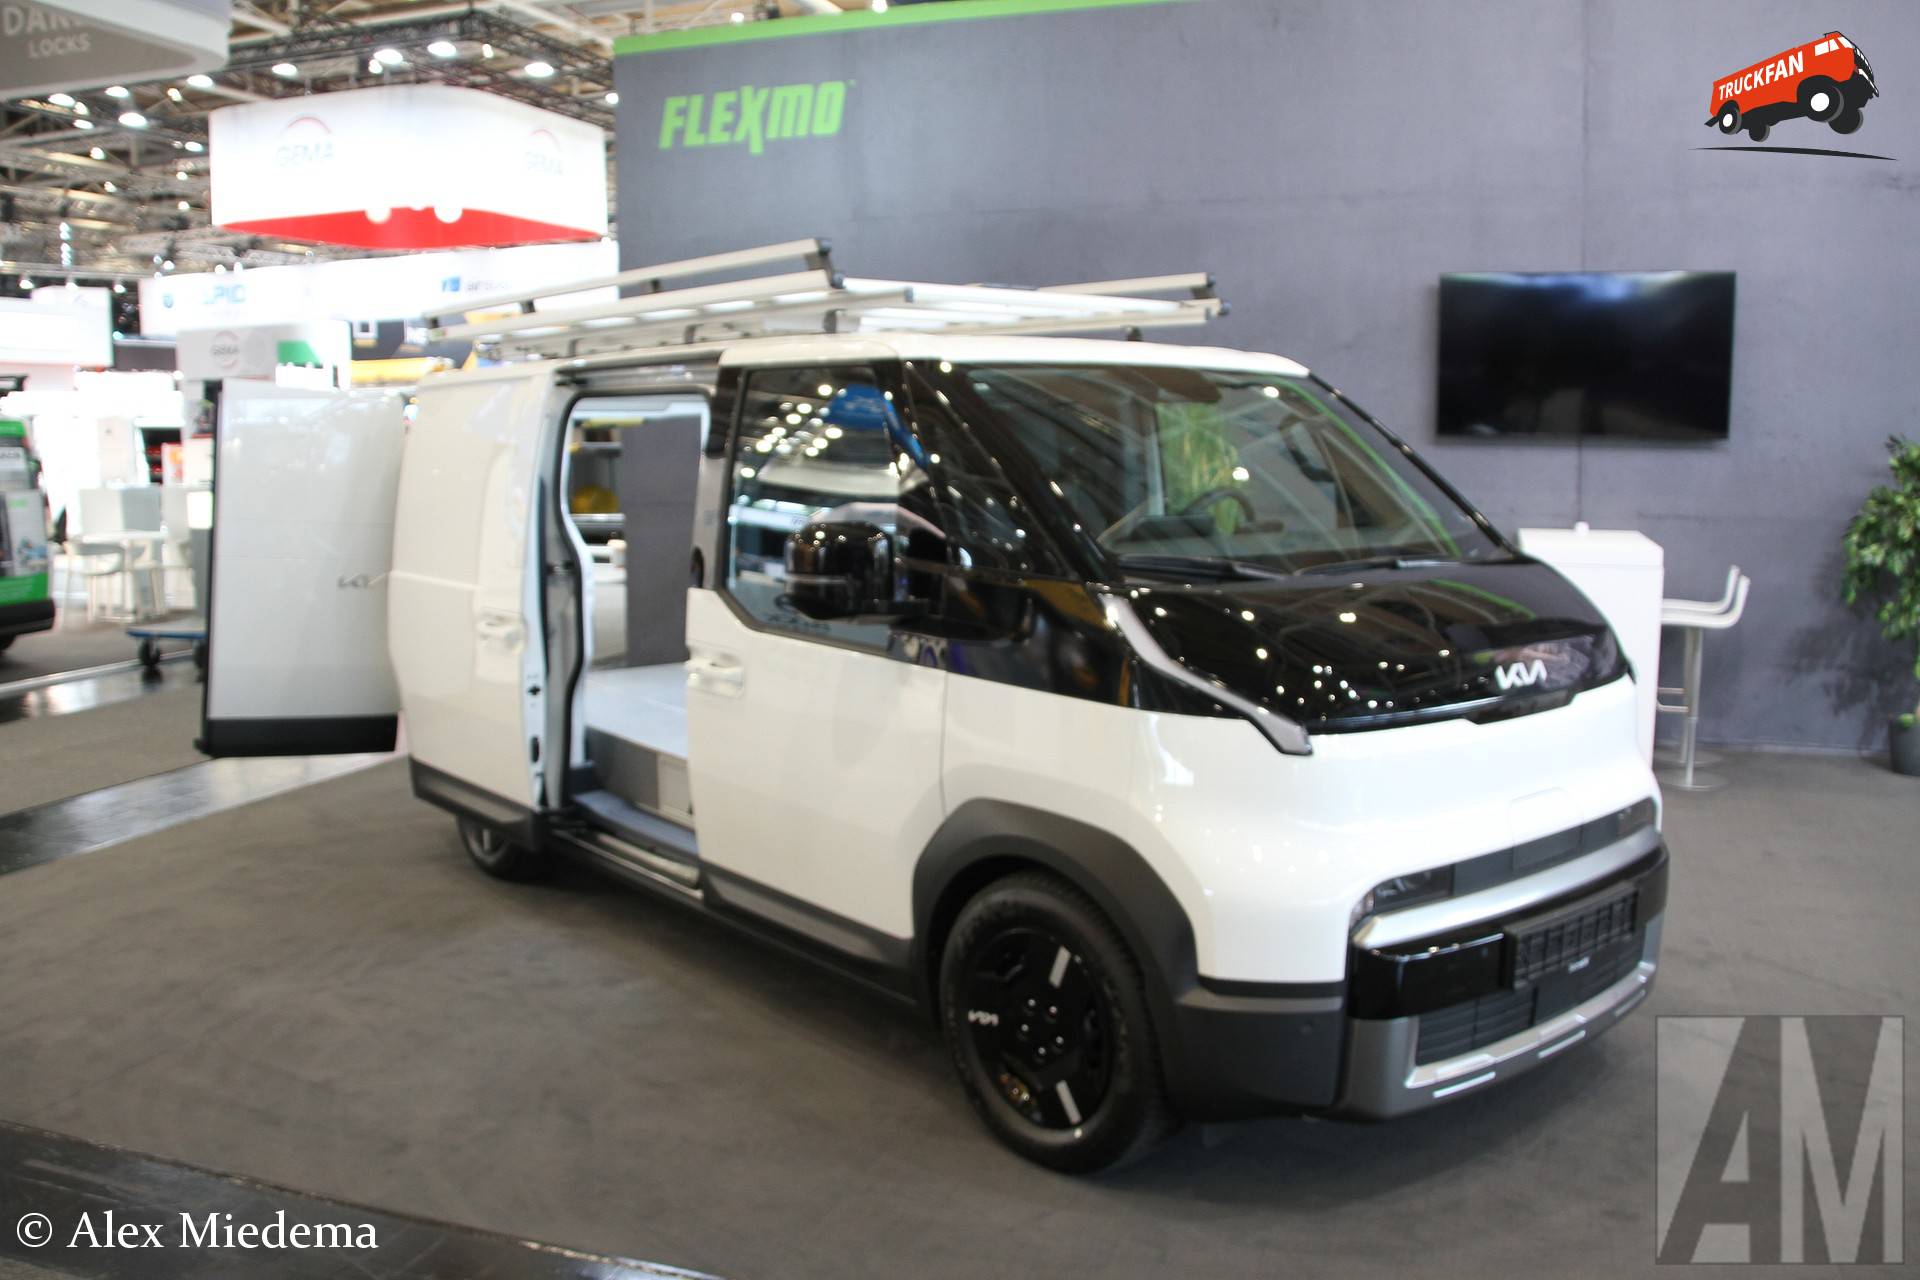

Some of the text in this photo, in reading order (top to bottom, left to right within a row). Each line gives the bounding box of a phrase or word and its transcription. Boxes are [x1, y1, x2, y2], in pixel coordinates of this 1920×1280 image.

[27, 33, 91, 58] LOCKS
[658, 81, 846, 155] FLEXMO
[1495, 659, 1548, 689] KIA
